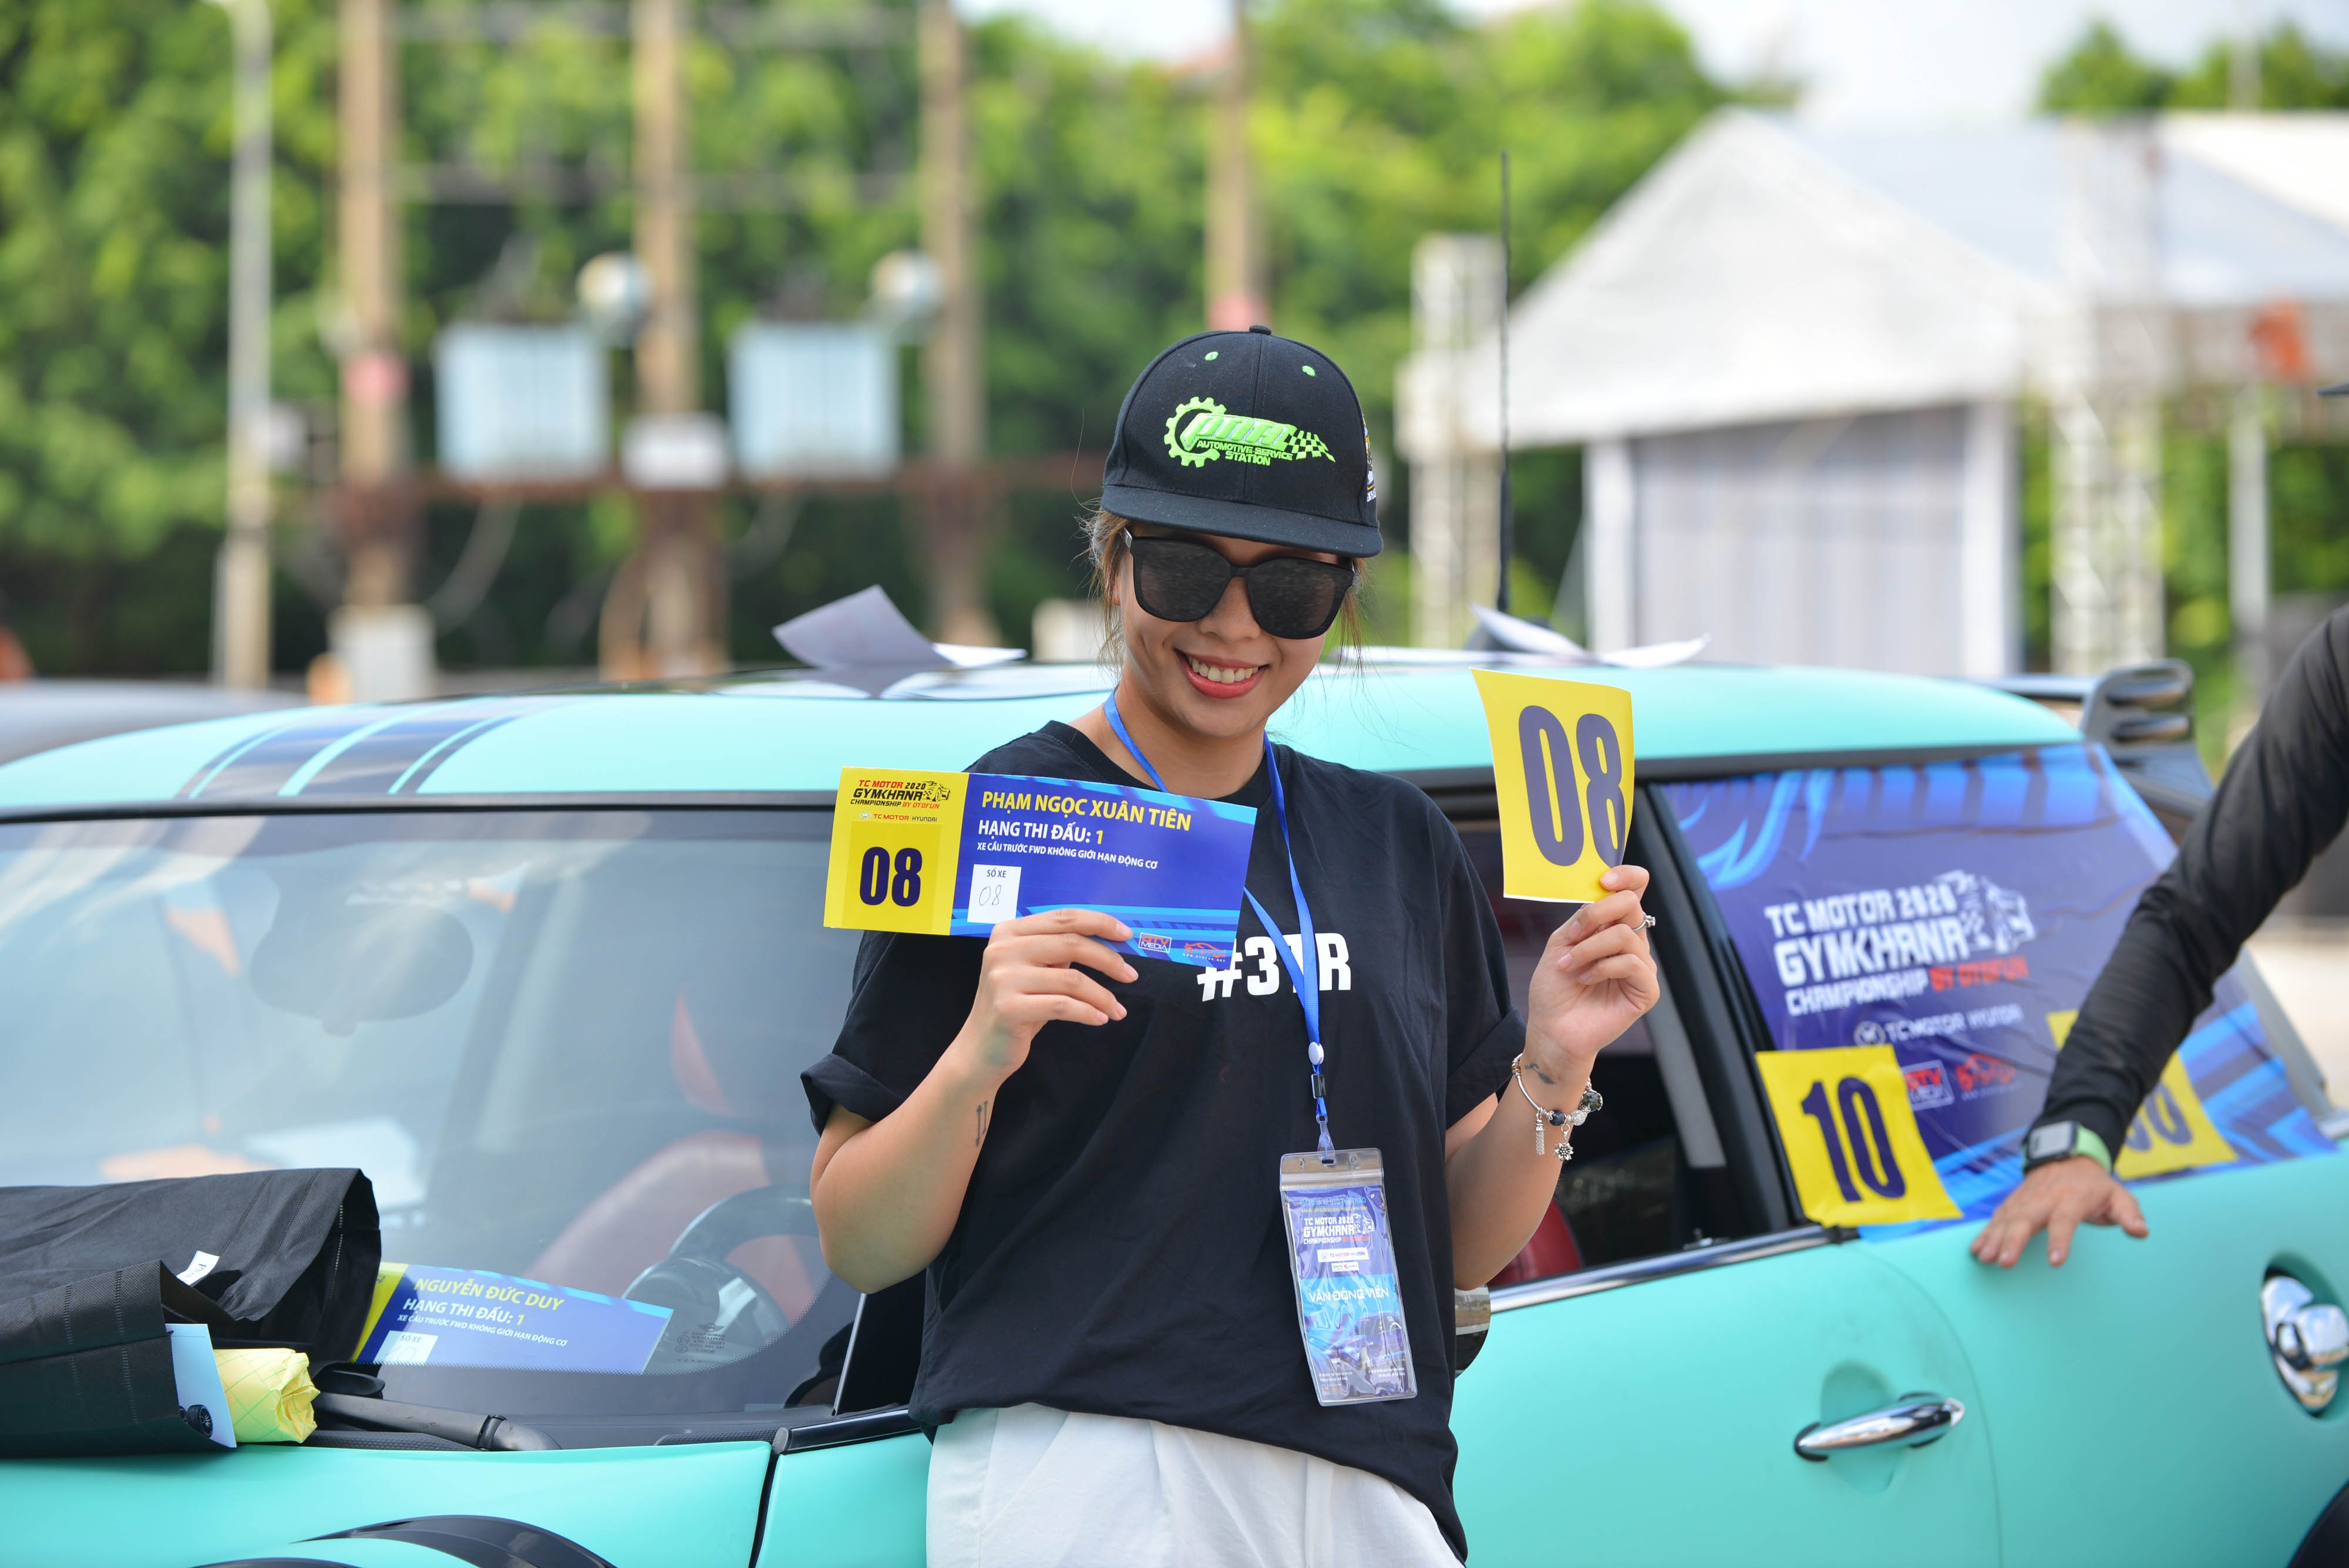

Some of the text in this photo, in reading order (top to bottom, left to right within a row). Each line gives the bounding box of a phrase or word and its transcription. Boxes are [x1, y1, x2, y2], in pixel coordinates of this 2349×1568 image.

[1197, 440, 1293, 460] AUTOMOTIVE SERVICE
[1225, 450, 1271, 466] STATION
[853, 788, 924, 801] GYMKHANA
[872, 780, 904, 789] MOTOR
[1519, 705, 1626, 869] 08
[850, 799, 901, 807] CHAMPIONSHIP
[982, 791, 1192, 831] PHẠM NGỌC XUÂN TIÊN
[978, 819, 1103, 844] HẠNG THI ĐẤU: 1
[977, 842, 987, 850] XE
[1003, 843, 1028, 853] TRƯỚC
[1029, 845, 1046, 854] FWD
[1047, 846, 1077, 857] KHÔNG
[1078, 849, 1096, 859] GIỚI
[1097, 852, 1116, 863] HẠN
[1118, 854, 1144, 867] ĐỘNG
[1145, 860, 1158, 869] CƠ
[859, 846, 923, 907] 08
[987, 867, 1007, 878] SỐ XE
[979, 884, 1001, 906] 08
[1765, 884, 1957, 938] TC MOTOR 2020
[1141, 941, 1167, 953] MEDIA
[1773, 915, 1971, 987] GYMKHANA
[1785, 968, 1930, 1017] CHAMPIONSHIP
[1801, 1077, 1907, 1203] 10
[1303, 1224, 1355, 1238] GYMKHANA
[1304, 1216, 1354, 1226] TC MOTOR 2020
[1303, 1237, 1342, 1245] CHAMPIONSHIP
[413, 1278, 565, 1311] NGUYỄN ĐỨC DUY
[1308, 1288, 1331, 1305] VẬN
[1366, 1284, 1389, 1299] VIÊN
[403, 1298, 526, 1325] HẠNG THI ĐẤU: 1
[397, 1314, 408, 1323] XE
[450, 1320, 469, 1330] FWD
[468, 1323, 496, 1334] KHÔNG
[496, 1327, 514, 1337] GIỚI
[513, 1331, 531, 1341] HẠN
[531, 1333, 555, 1345] ĐỘNG
[556, 1338, 568, 1347] CƠ
